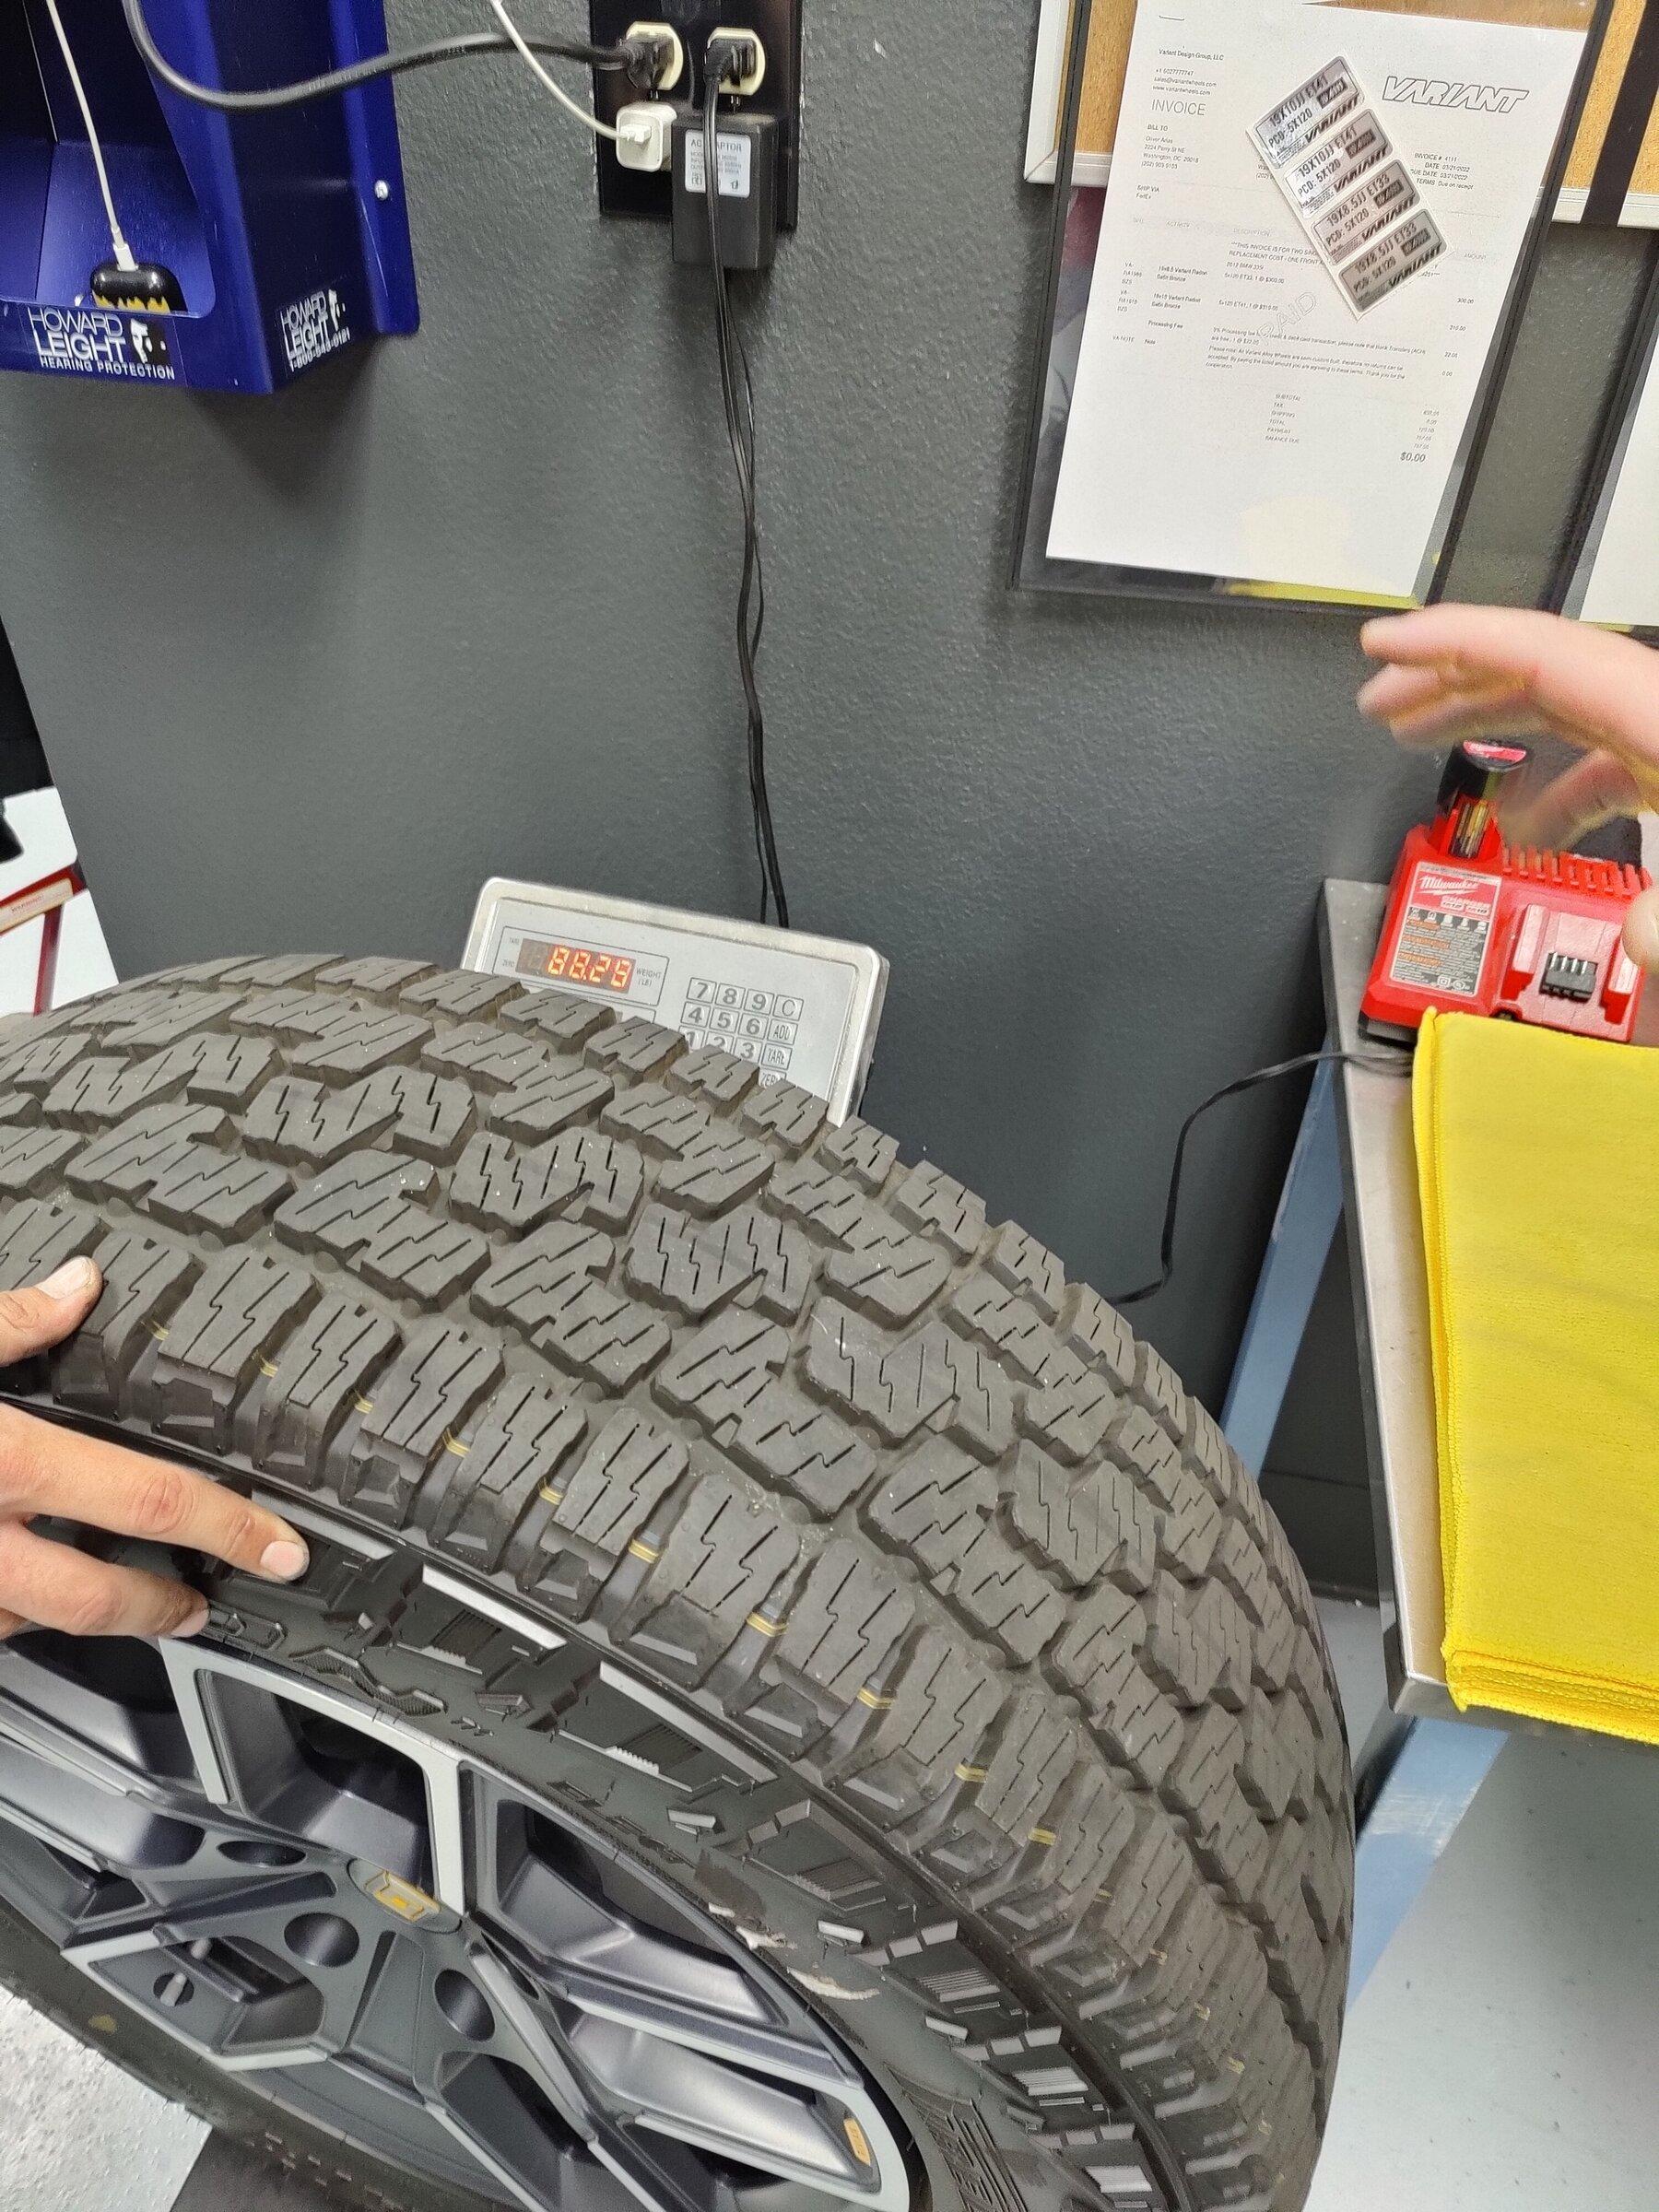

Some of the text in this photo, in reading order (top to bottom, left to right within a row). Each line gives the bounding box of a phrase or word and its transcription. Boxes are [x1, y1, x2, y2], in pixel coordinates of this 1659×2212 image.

[1159, 48, 1177, 57] Variant
[1177, 50, 1195, 58] Design
[1195, 52, 1213, 61] Group,
[1382, 76, 1530, 113] VARIANT
[1151, 99, 1206, 116] INVOICE
[1287, 108, 1313, 133] 5X120
[1298, 144, 1335, 178] 19X10JJ
[1298, 159, 1341, 197] PCD: 5X120
[1422, 171, 1438, 179] DATE
[1345, 208, 1370, 231] 5X120
[28, 306, 124, 337] HOWARD
[32, 328, 127, 363] LEIGHT
[40, 355, 175, 381] HEARING PROTECTION
[1399, 451, 1427, 463] $0.00
[635, 967, 663, 980] WEIGHT
[697, 982, 795, 1017] 7 8 9 C
[688, 1006, 791, 1041] 4 5 6 ADD
[740, 1042, 755, 1059] 3
[767, 1049, 785, 1065] TARE
